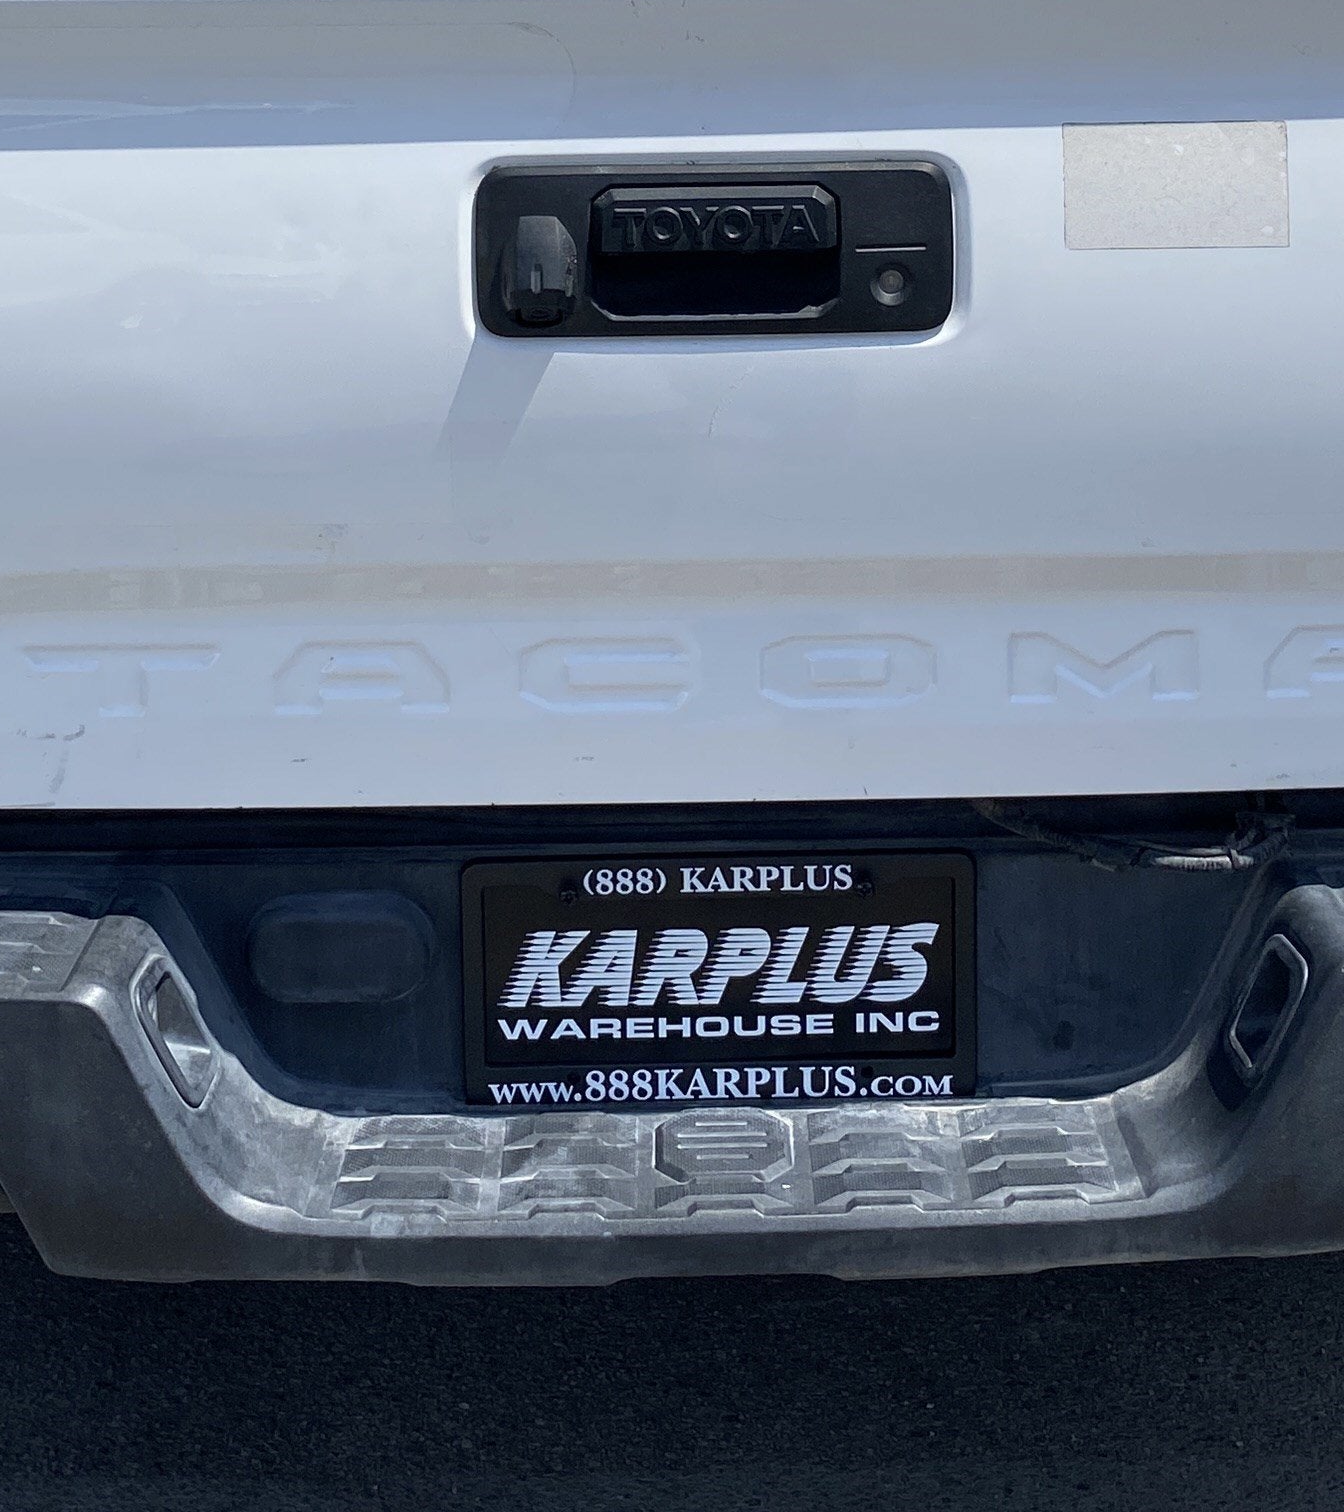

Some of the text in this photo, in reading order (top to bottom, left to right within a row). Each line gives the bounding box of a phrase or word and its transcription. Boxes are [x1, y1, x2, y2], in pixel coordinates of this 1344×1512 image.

[612, 202, 823, 246] TOYOTA
[583, 864, 853, 896] (888) KARPLUS
[497, 922, 940, 1008] KARPLUS
[497, 1011, 940, 1040] WAREHOUSE INC
